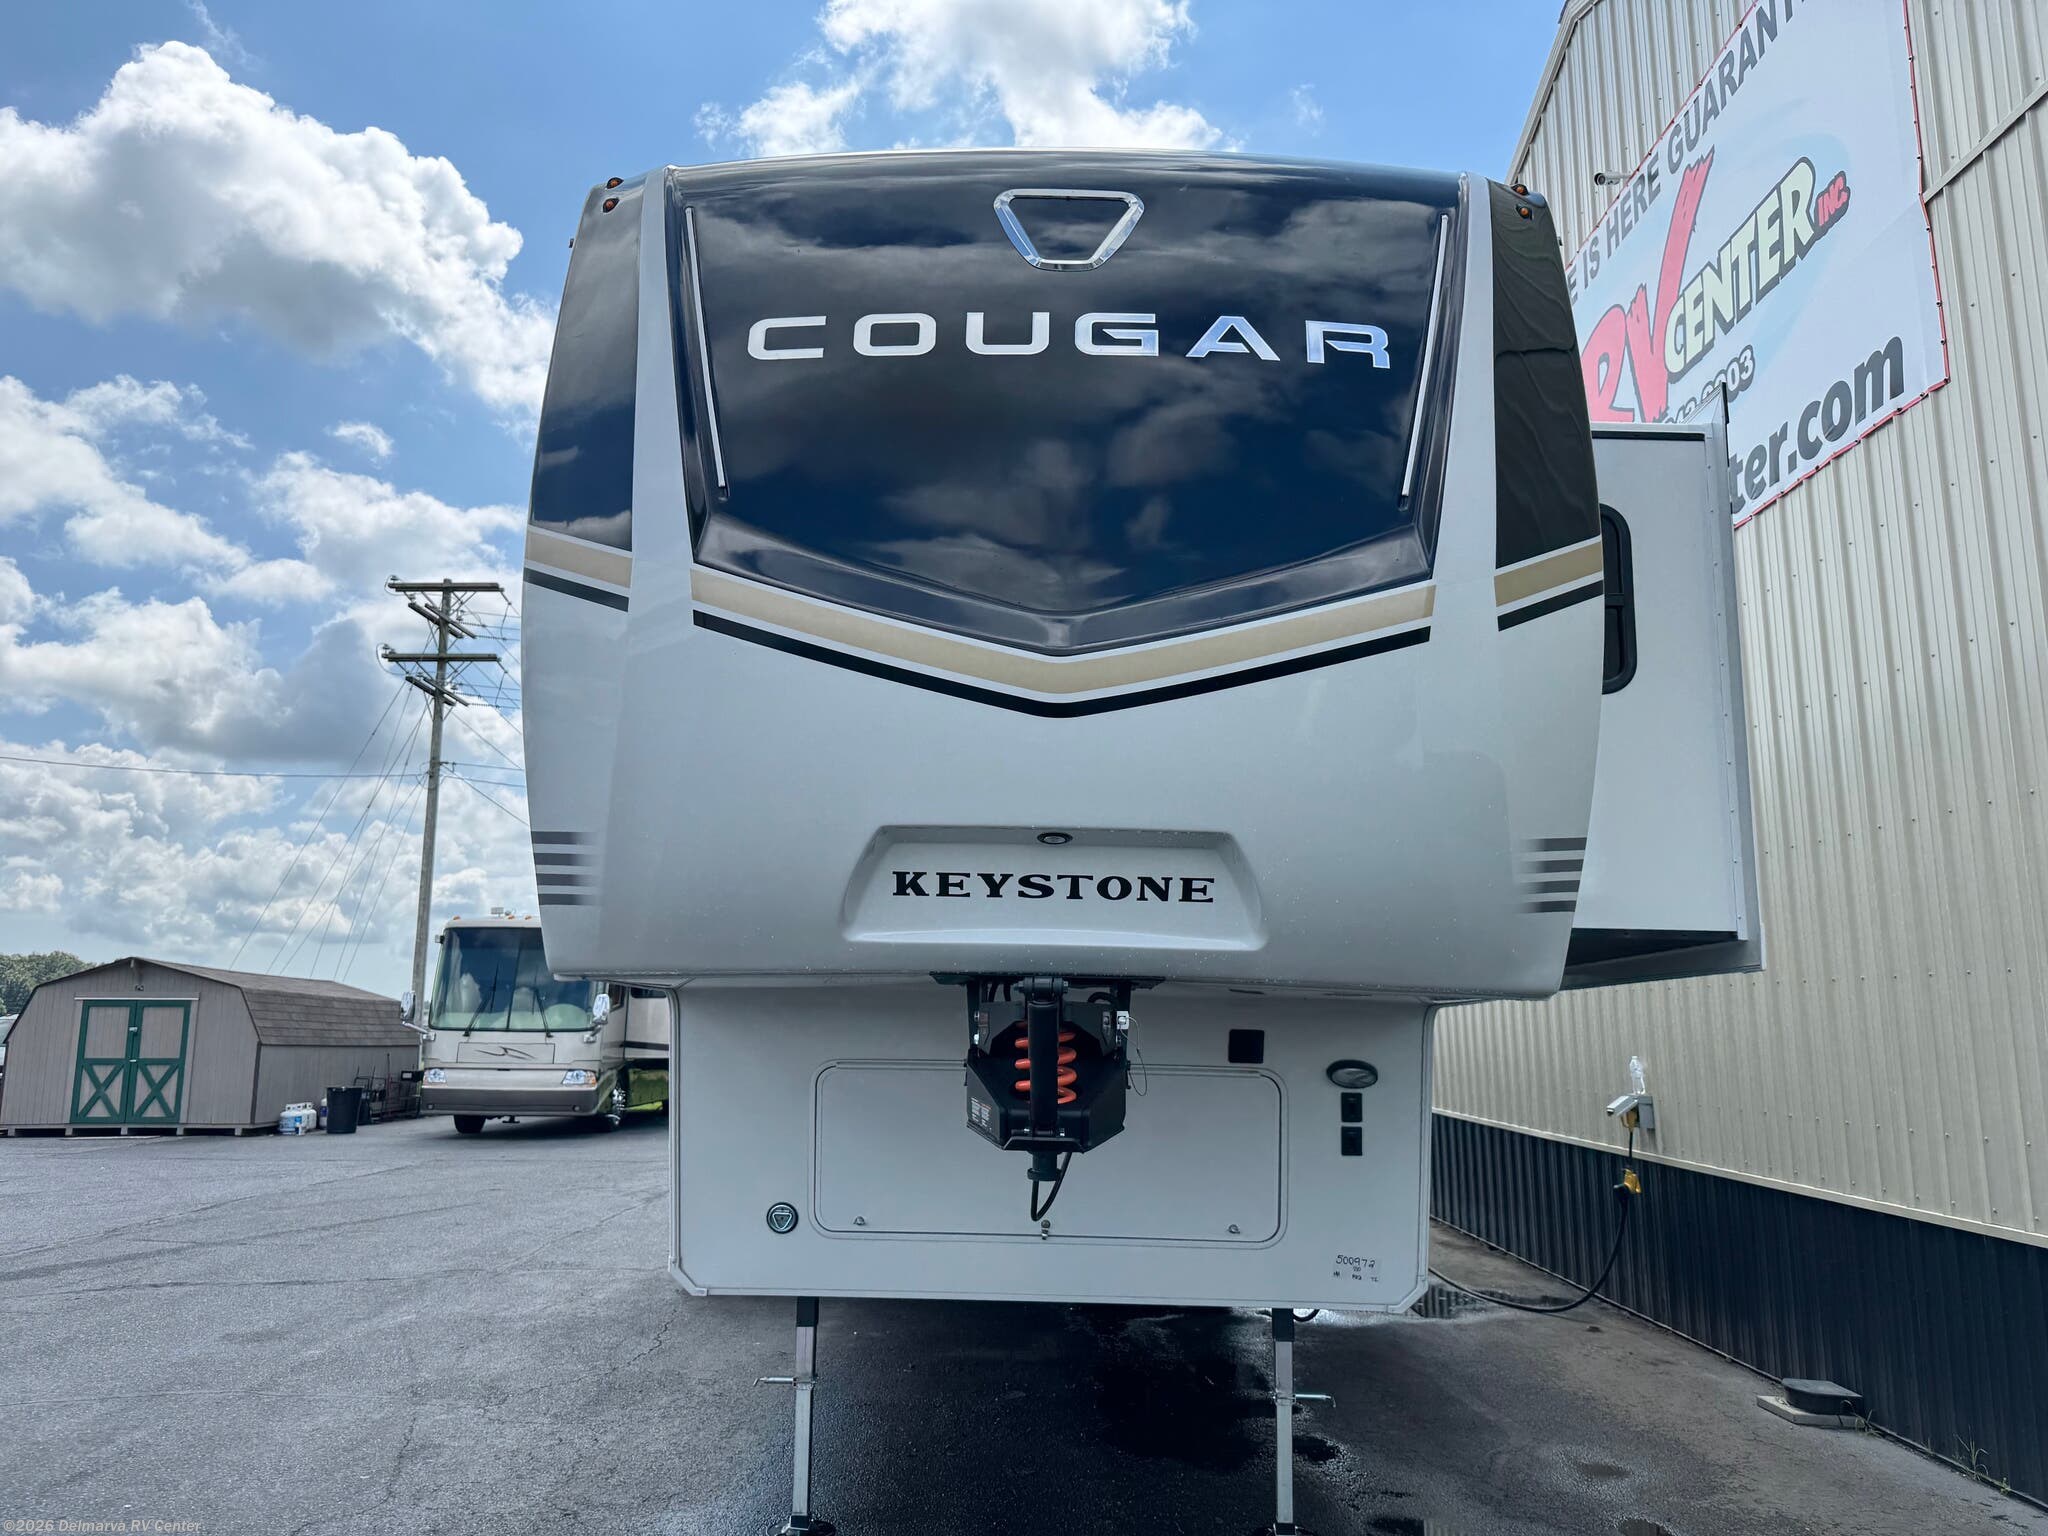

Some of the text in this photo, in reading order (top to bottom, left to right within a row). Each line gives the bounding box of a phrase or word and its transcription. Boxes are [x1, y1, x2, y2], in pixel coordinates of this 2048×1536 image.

[1565, 263, 1579, 307] E
[1583, 236, 1600, 289] IS
[1606, 152, 1661, 259] HERE
[1664, 158, 1816, 382] CENTER
[747, 312, 1391, 369] COUGAR
[1728, 336, 1905, 514] ter.com
[892, 871, 1215, 903] KEYSTONE
